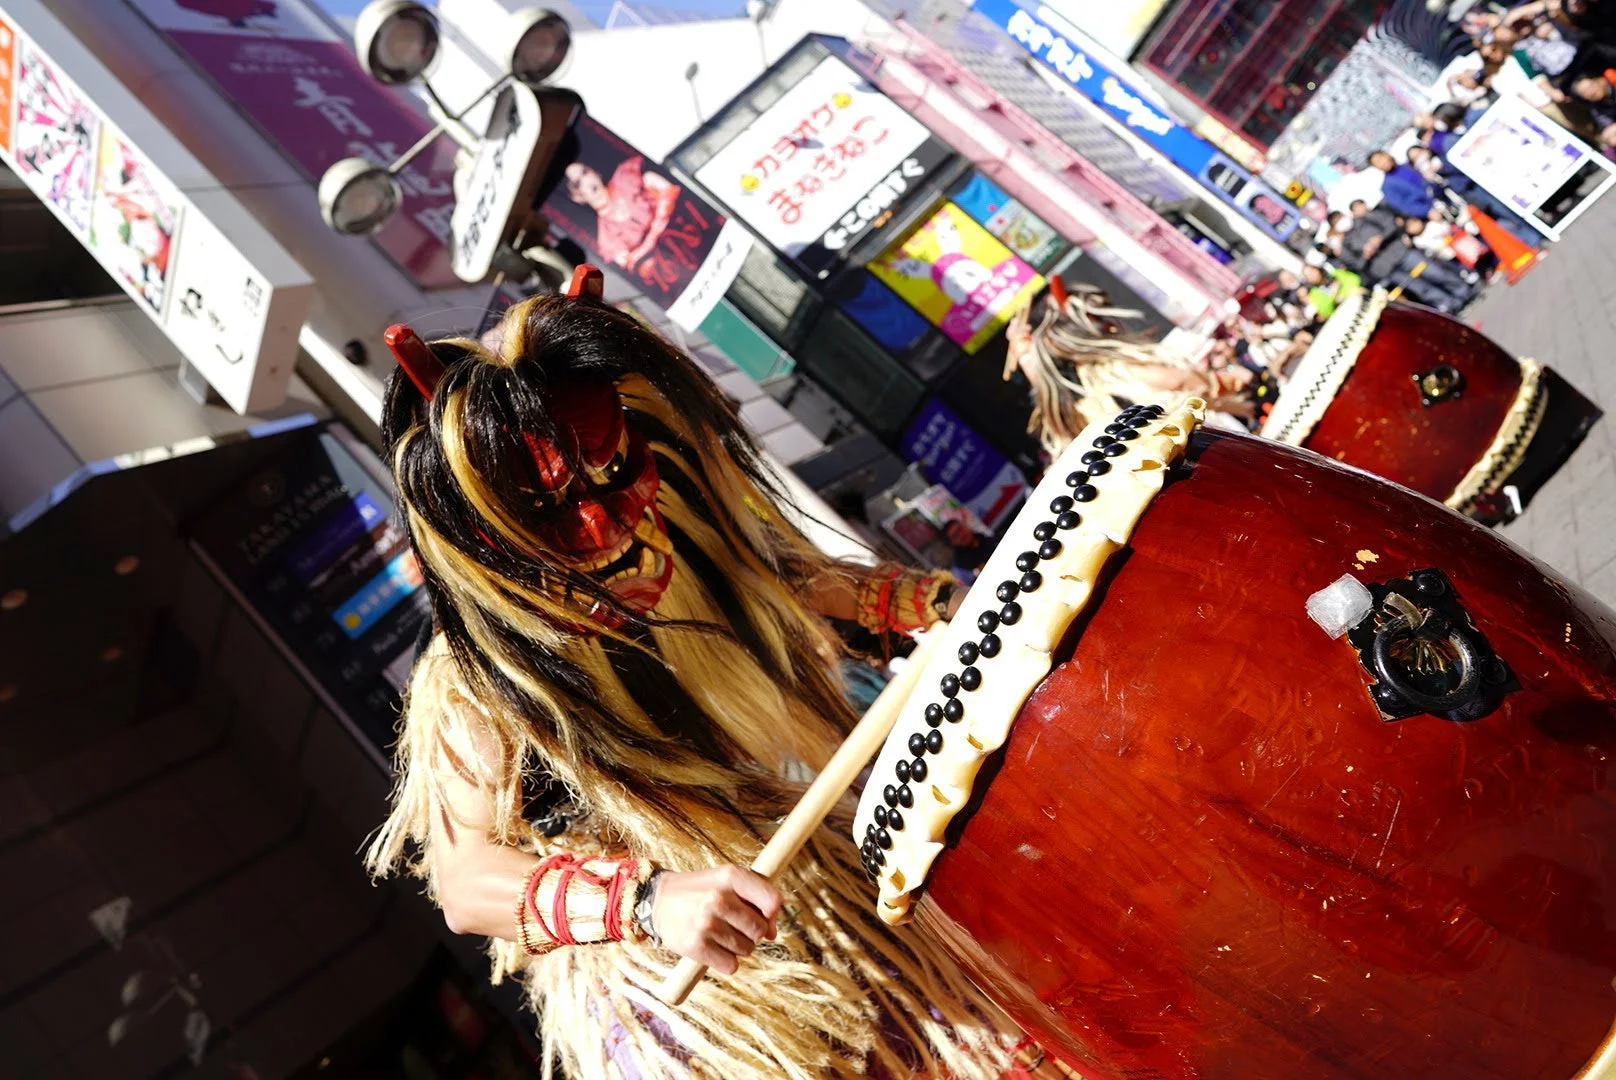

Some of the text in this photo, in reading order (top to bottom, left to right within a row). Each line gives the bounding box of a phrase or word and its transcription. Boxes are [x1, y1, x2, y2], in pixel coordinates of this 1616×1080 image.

[753, 103, 835, 178] カラオケ
[767, 115, 890, 225] まねきねこ
